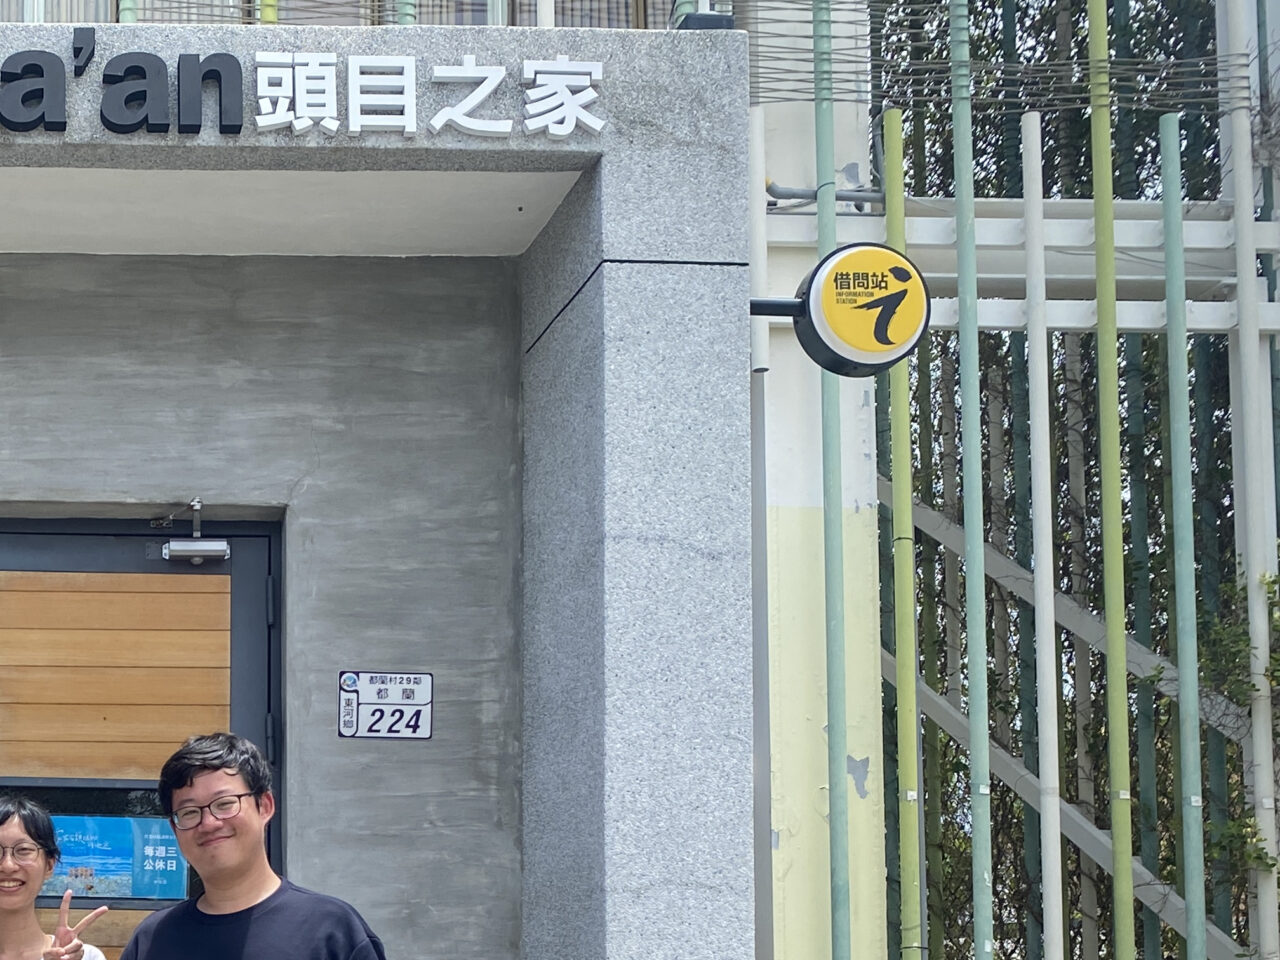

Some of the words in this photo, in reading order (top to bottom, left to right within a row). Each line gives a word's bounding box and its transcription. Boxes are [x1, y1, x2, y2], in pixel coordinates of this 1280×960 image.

[255, 52, 606, 138] 頭目之家
[833, 271, 889, 291] 借問站
[366, 708, 422, 734] 224
[143, 845, 178, 857] 每週三
[143, 859, 177, 872] 公休日
